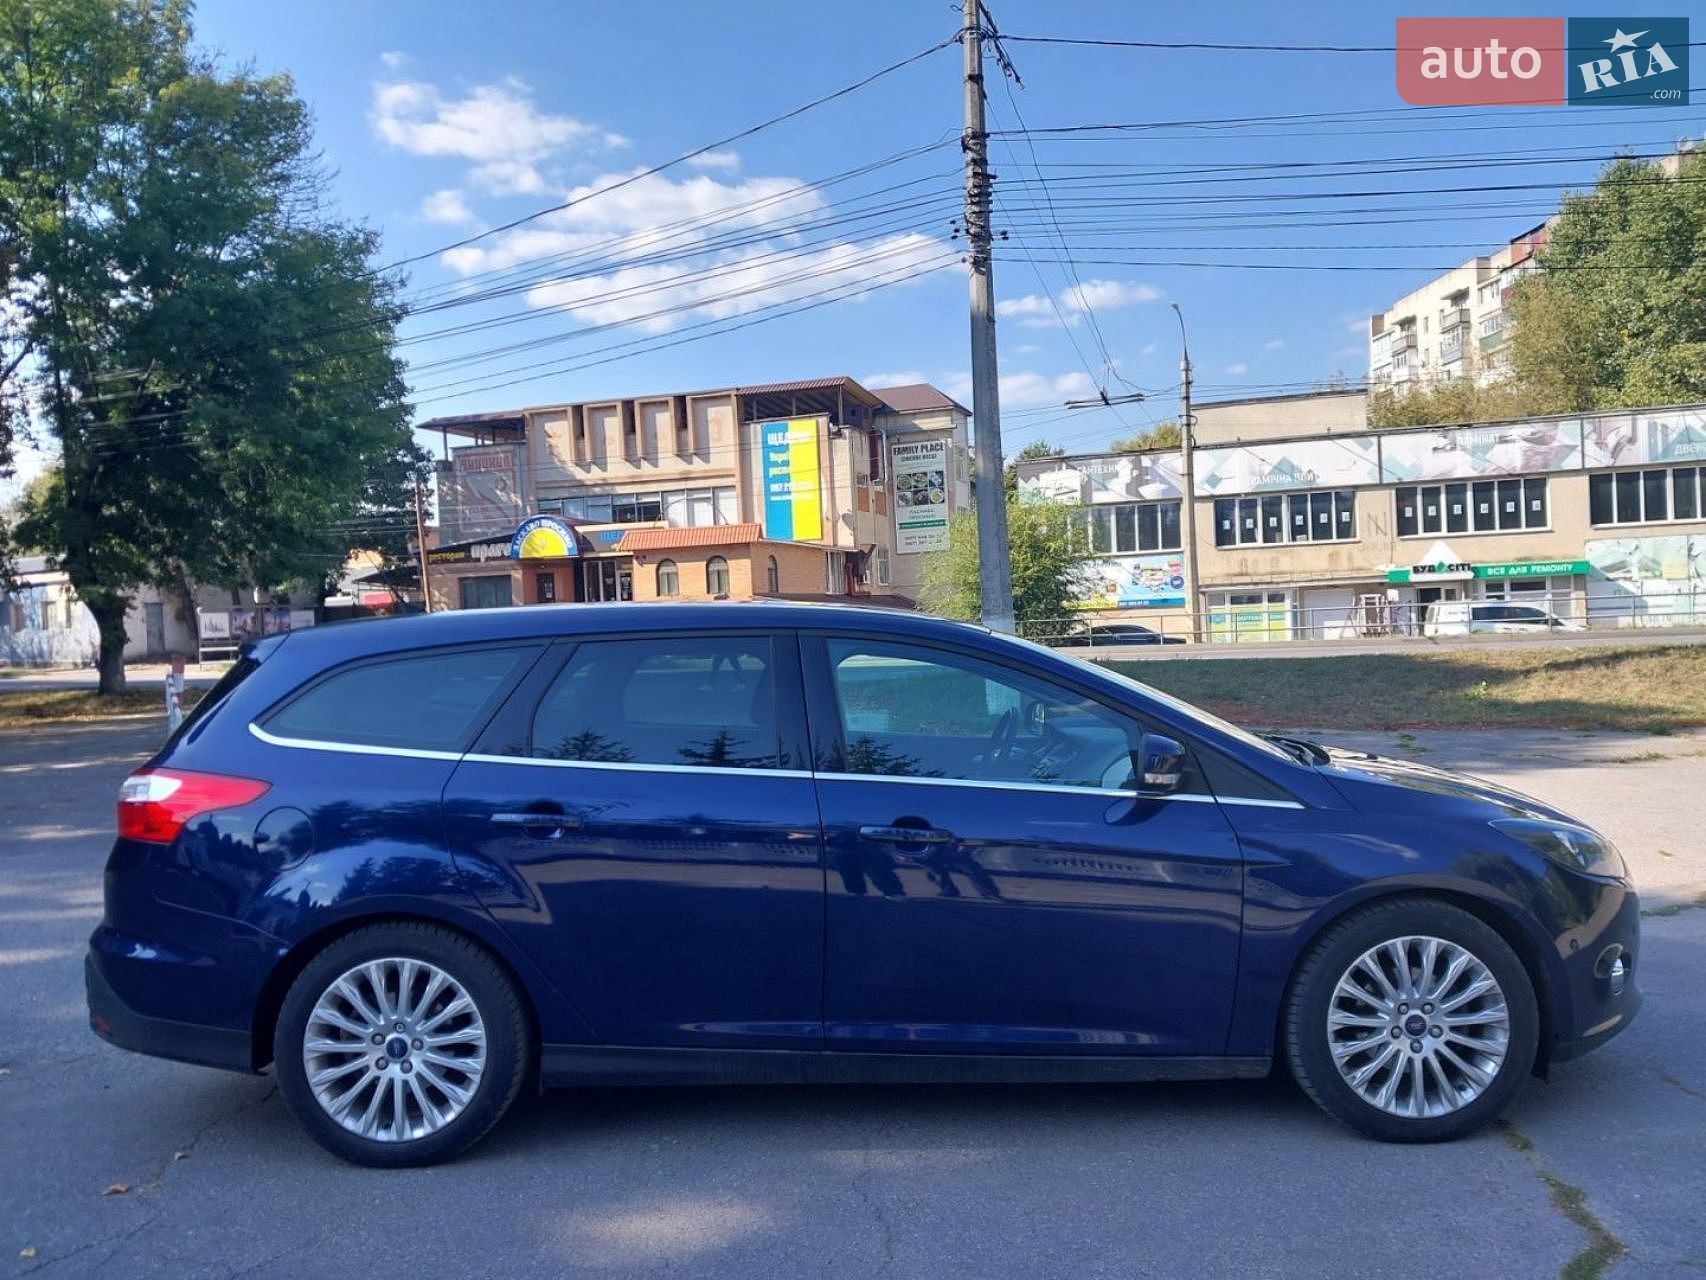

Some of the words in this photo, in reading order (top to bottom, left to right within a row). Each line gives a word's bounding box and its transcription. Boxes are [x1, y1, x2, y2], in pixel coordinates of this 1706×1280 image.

[893, 446, 919, 456] FAMILY
[920, 442, 944, 453] PLACE
[1412, 563, 1436, 574] БУД
[1487, 566, 1505, 575] ВСЕ
[1508, 566, 1528, 575] ДЛЯ
[1531, 564, 1573, 574] РЕМОНТУ
